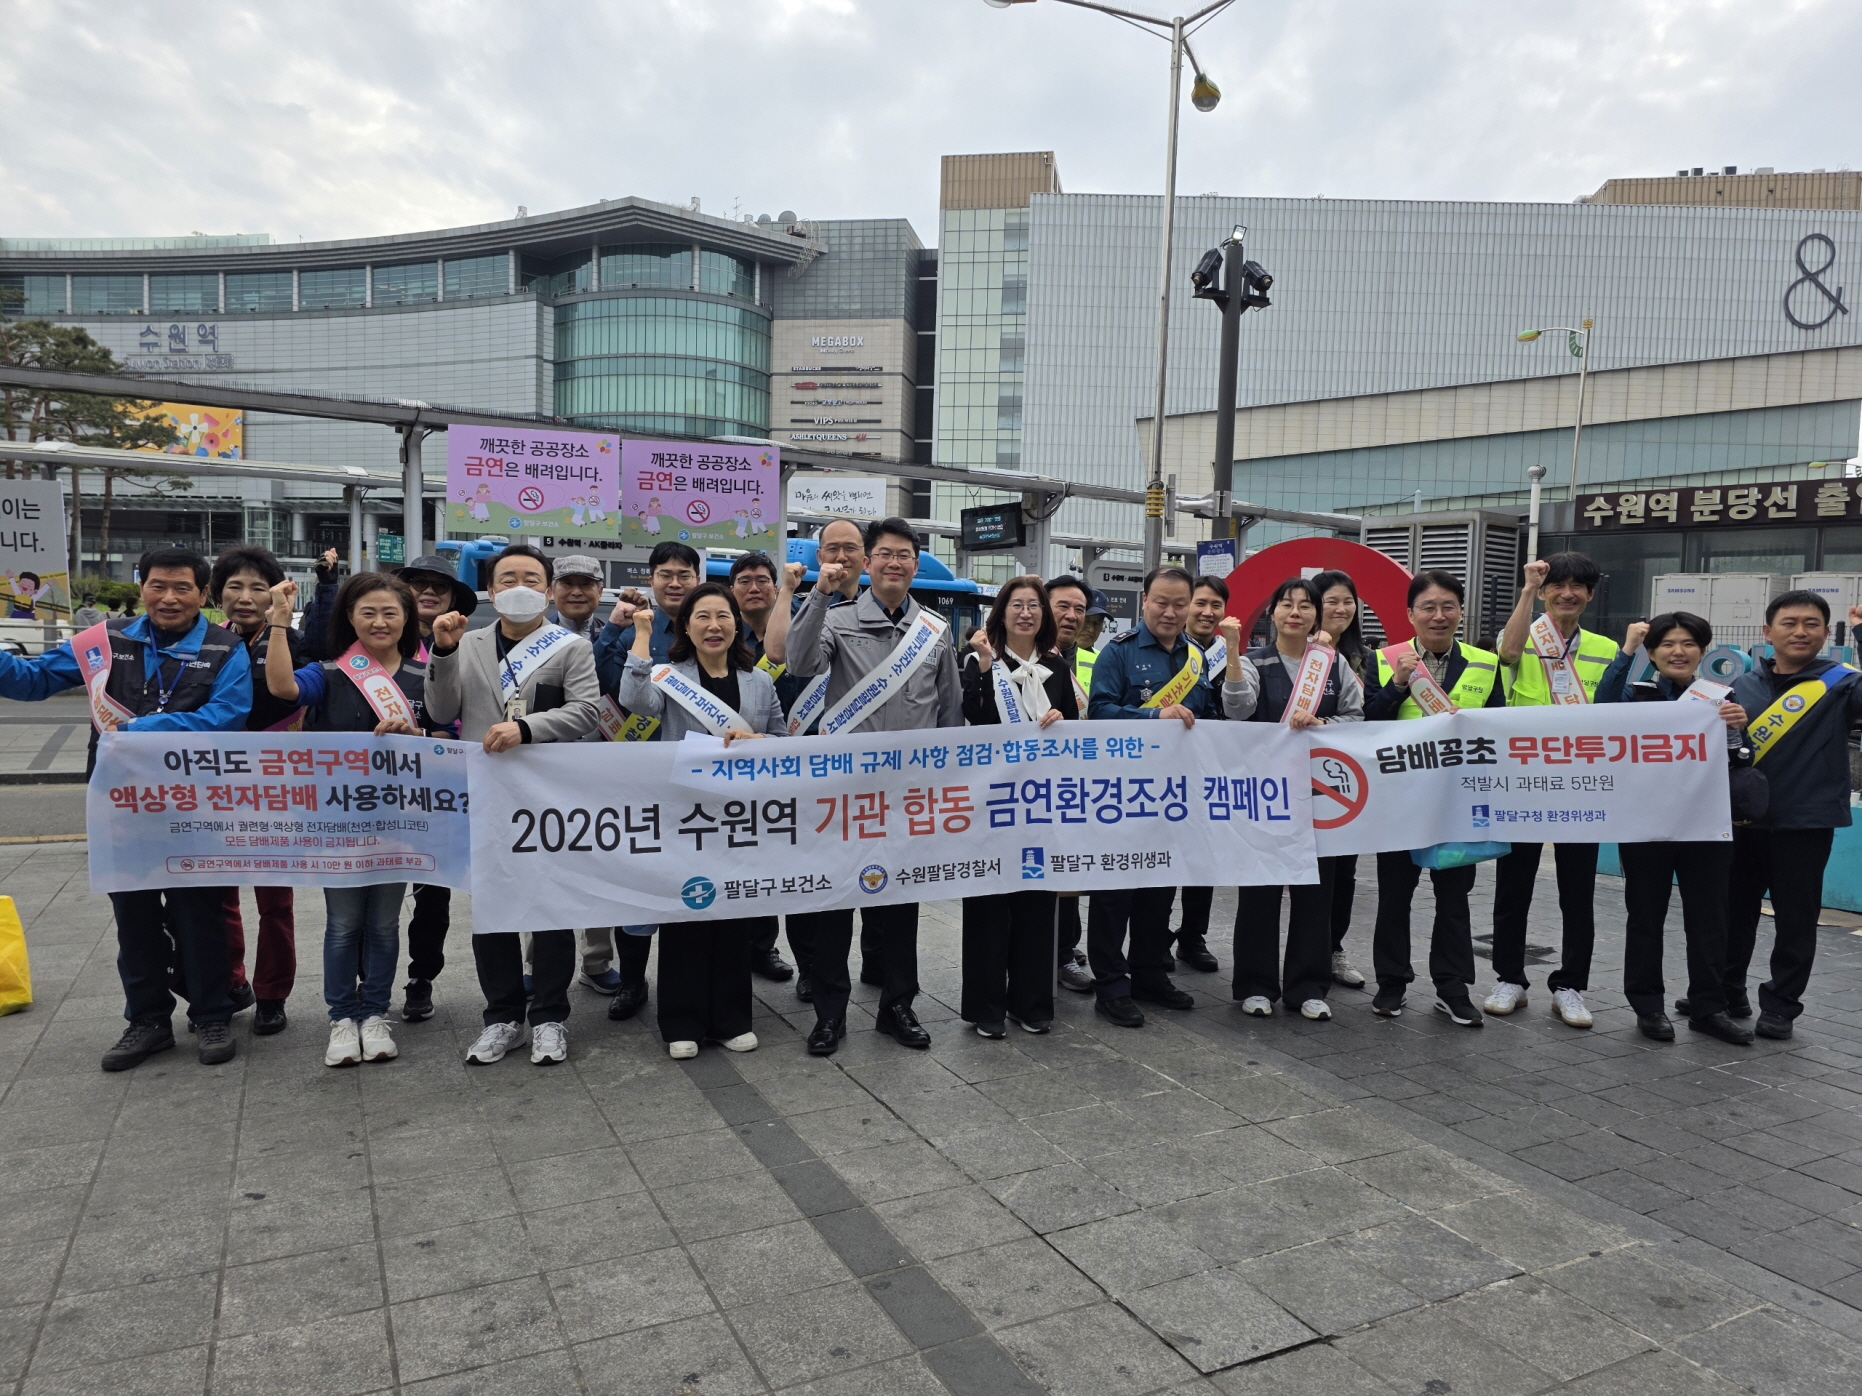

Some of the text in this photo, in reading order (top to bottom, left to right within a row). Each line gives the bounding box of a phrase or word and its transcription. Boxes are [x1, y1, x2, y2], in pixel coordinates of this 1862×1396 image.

[139, 323, 219, 353] 수원역
[811, 336, 864, 348] MEGABOX
[162, 356, 200, 370] Station
[813, 416, 834, 425] VIPS
[479, 438, 590, 458] 깨끗한 공공장소
[464, 456, 603, 482] 금연은 배려입니다.
[650, 452, 752, 471] 깨끗한 공공장소
[636, 470, 764, 495] 금연은 배려입니다.
[1583, 481, 1862, 527] 수원역 분당선 출
[542, 520, 560, 528] 보건소
[545, 537, 552, 545] 5
[558, 537, 582, 548] 수원역
[937, 597, 954, 605] 1069
[525, 627, 573, 658] 구보건소
[1293, 659, 1324, 716] 전자담배
[373, 685, 409, 725] 전자
[664, 675, 730, 728] 팔달구보건소
[826, 677, 889, 734] 수원팔달경찰서
[998, 678, 1022, 723] 수원팔달
[1418, 686, 1448, 715] 담배
[163, 747, 422, 779] 아직도 금연구역에서
[446, 747, 466, 755] 팔달구
[712, 755, 801, 782] 지역사회
[808, 751, 853, 778] 담배
[859, 748, 902, 774] 규제
[908, 746, 950, 771] 사항
[955, 736, 1099, 769] 점검·합동조사를
[1105, 736, 1145, 759] 위한
[1376, 732, 1708, 775] 담배꽁초 무단투기금지
[1460, 774, 1615, 793] 적발시 과태료 5만원
[109, 783, 469, 815] 액상형 전자담배 사용하세요?
[169, 820, 234, 834] 금연구역에서
[511, 775, 1292, 855] 2026년 수원역 기관 합동 금연환경조성 캠페인
[1494, 808, 1607, 824] 팔달구청 환경위생과
[225, 835, 380, 848] 모든 담배제품 사용이 금지됩니다.
[197, 855, 423, 871] 금연구역에서 담배제품 사용 시 10만 원 이하 과태료 부과
[895, 857, 1002, 886] 수원팔달경찰서
[1050, 850, 1172, 874] 팔달구 환경위생과
[723, 874, 833, 900] 팔달구 보건소
